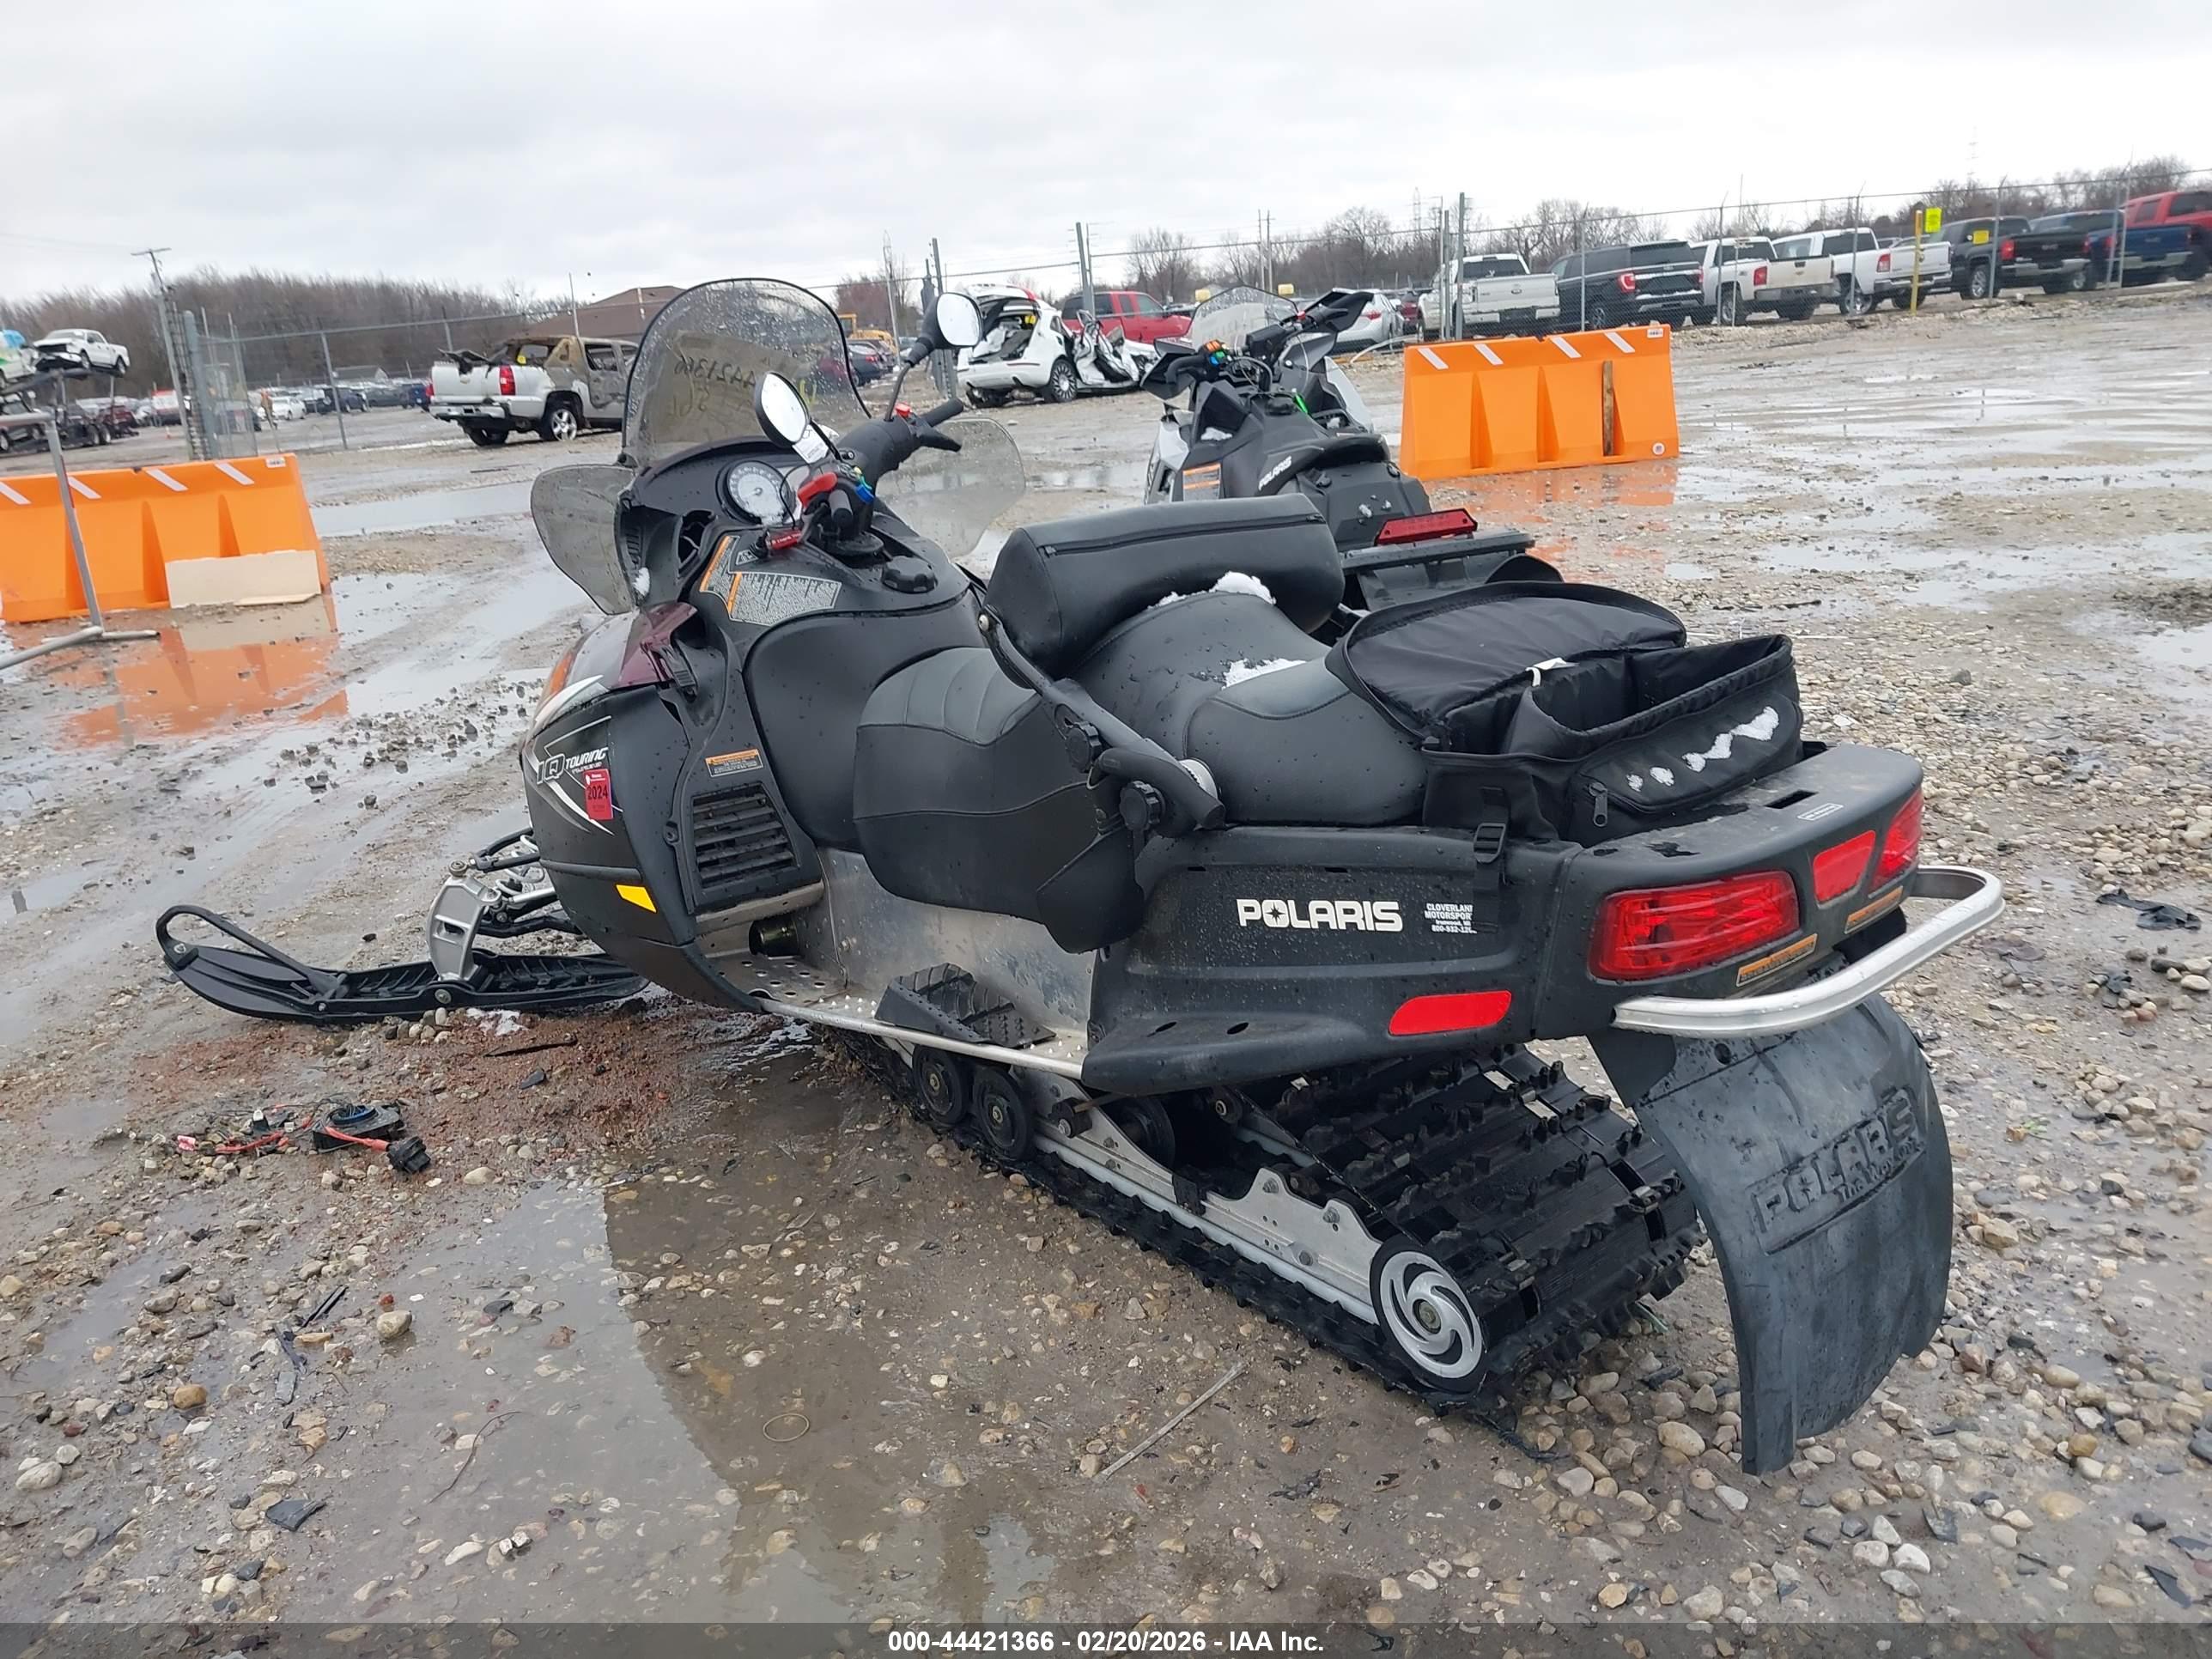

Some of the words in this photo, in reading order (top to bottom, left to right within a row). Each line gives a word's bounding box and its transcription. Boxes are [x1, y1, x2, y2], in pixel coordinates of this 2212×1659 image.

[1257, 455, 1292, 491] POLARIS
[565, 746, 609, 770] TOURING
[586, 784, 608, 800] 2024
[1237, 898, 1403, 932] POLARIS
